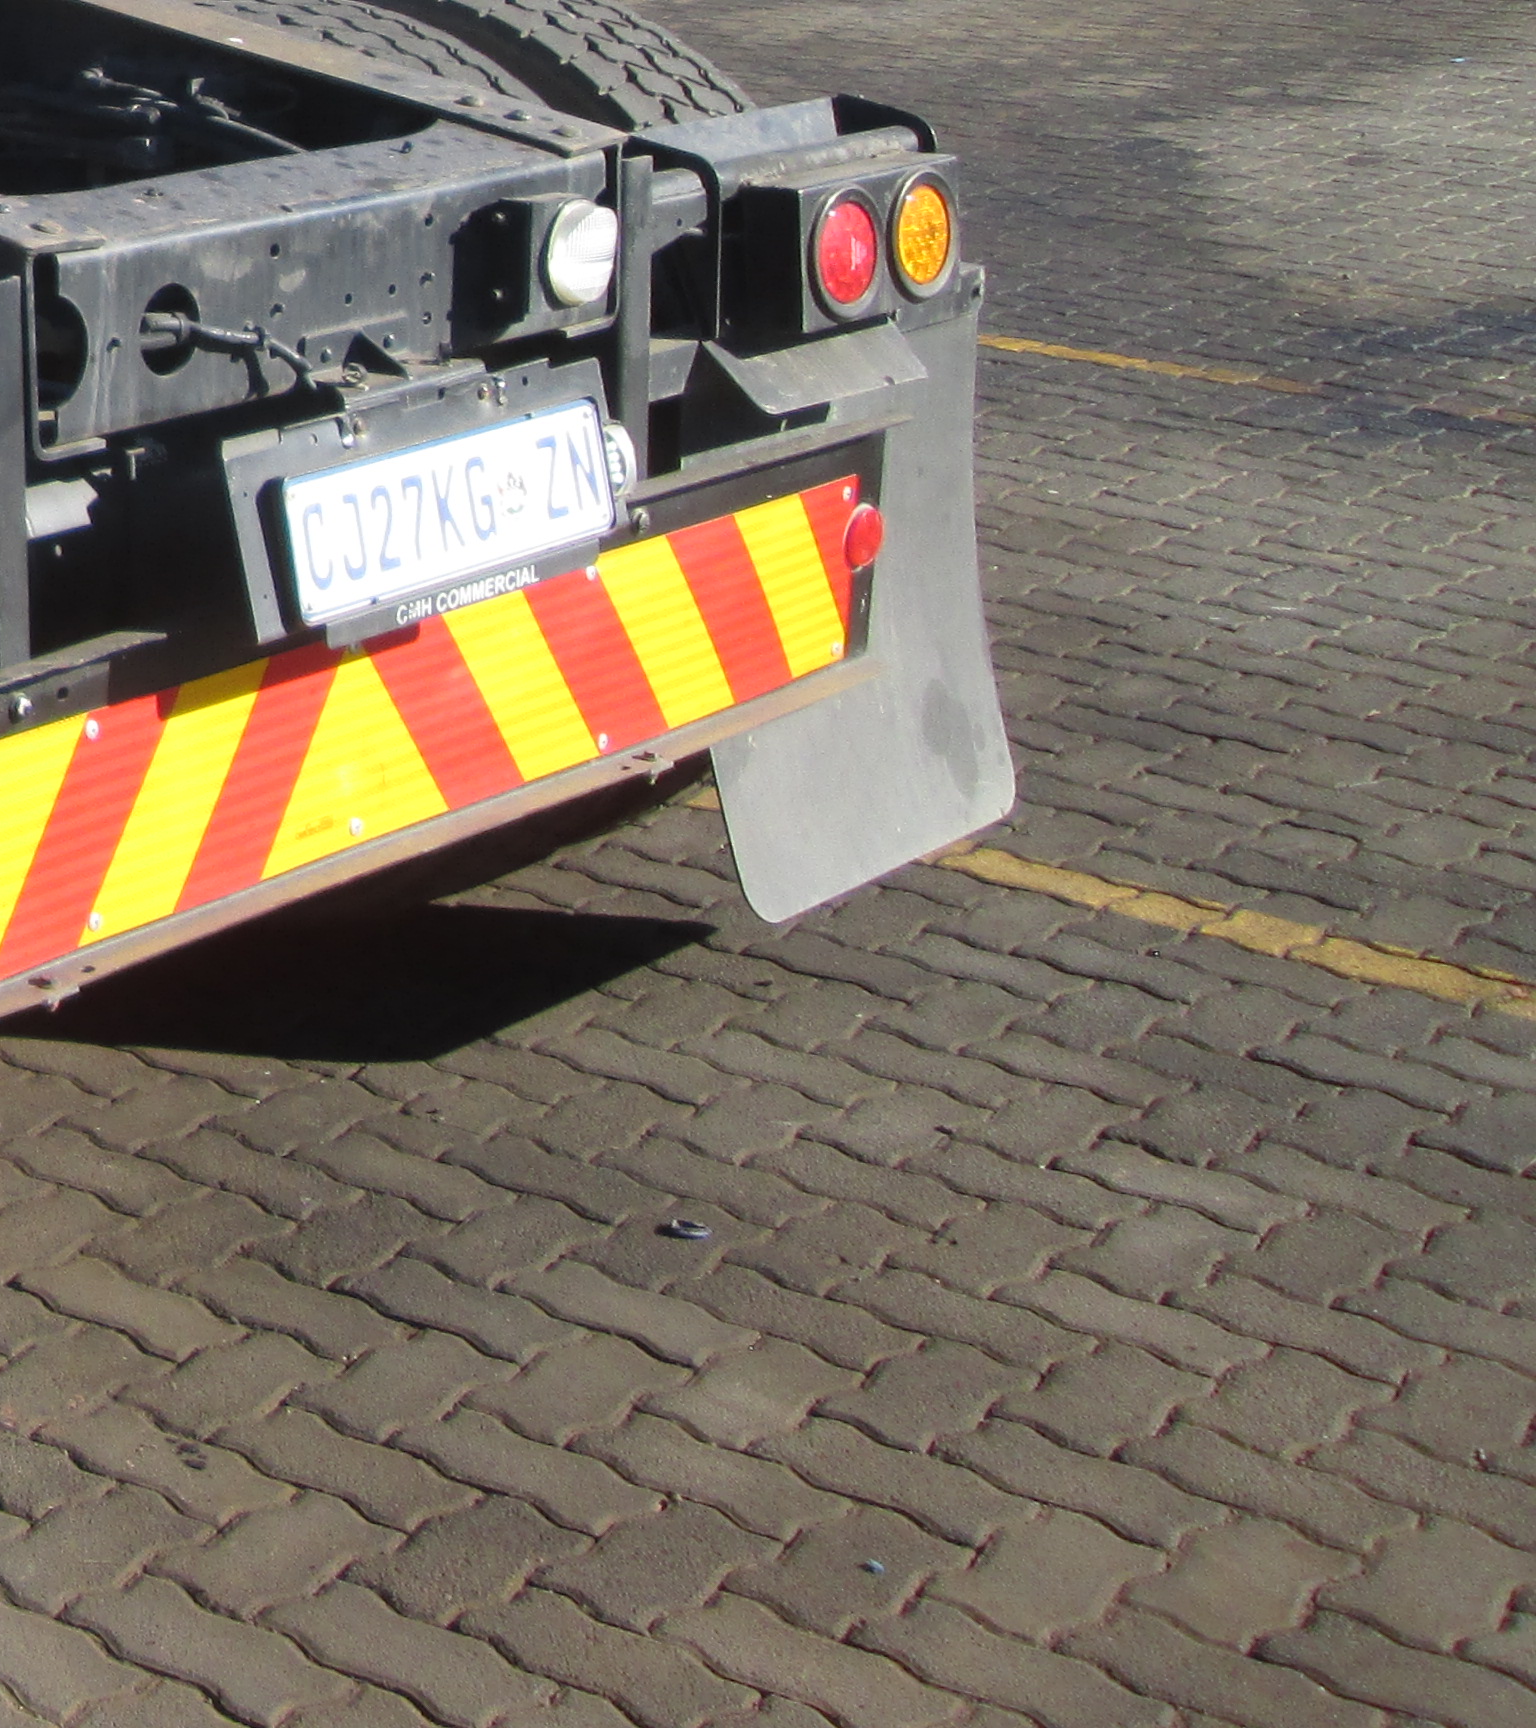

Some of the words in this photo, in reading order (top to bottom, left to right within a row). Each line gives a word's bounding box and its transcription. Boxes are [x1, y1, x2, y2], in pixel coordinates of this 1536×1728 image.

[535, 425, 602, 520] ZN
[396, 596, 433, 625] CMH
[436, 564, 540, 613] COMMERCIAL
